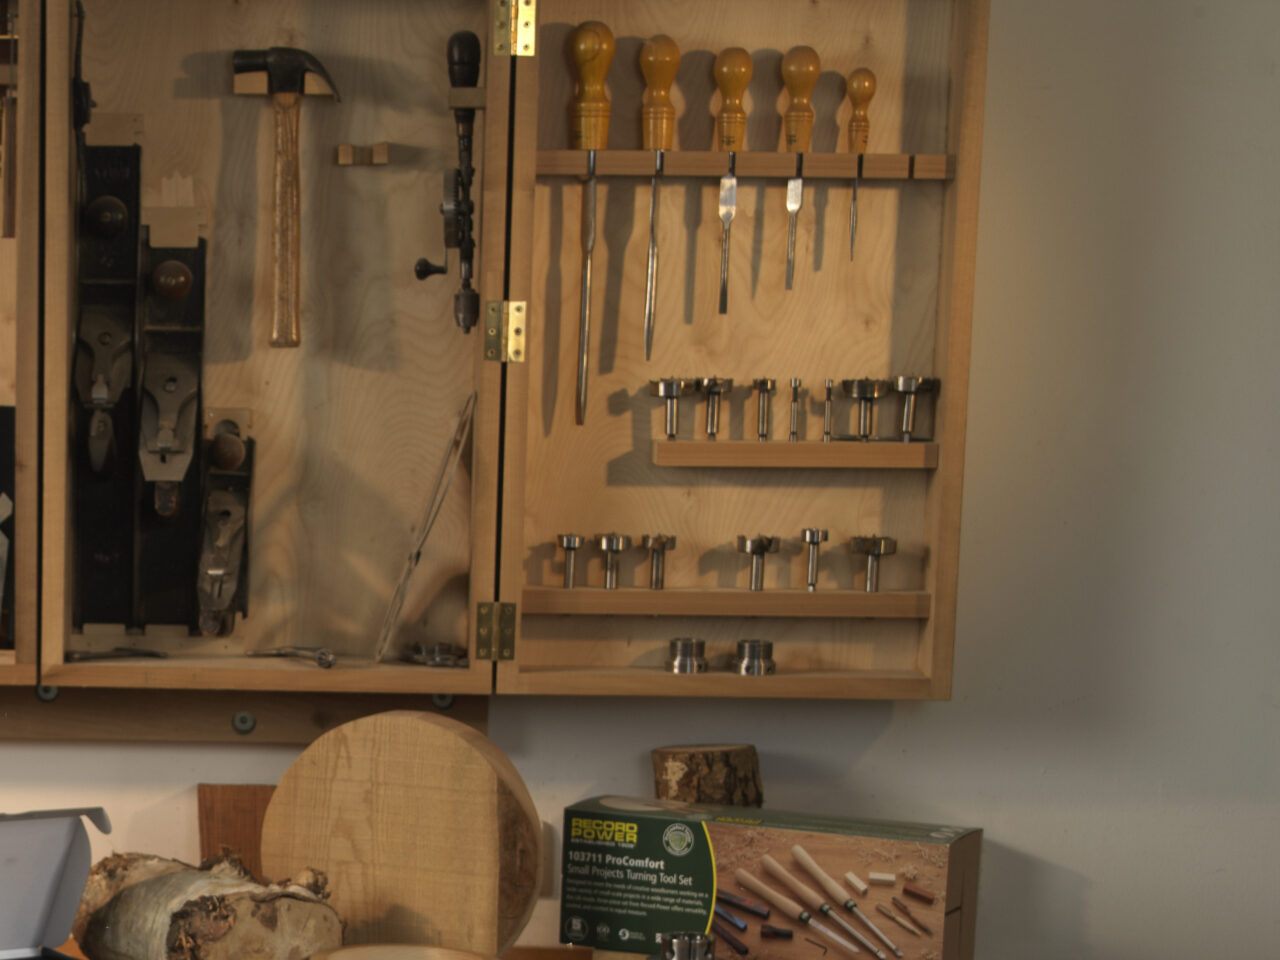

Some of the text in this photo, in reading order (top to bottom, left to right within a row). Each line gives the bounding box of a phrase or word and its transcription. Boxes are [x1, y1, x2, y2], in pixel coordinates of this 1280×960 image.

[571, 817, 638, 833] RECORD
[571, 828, 638, 844] POWER
[568, 850, 665, 870] 103711 ProComfort
[567, 863, 693, 887] Small Projects Turning Tool Set
